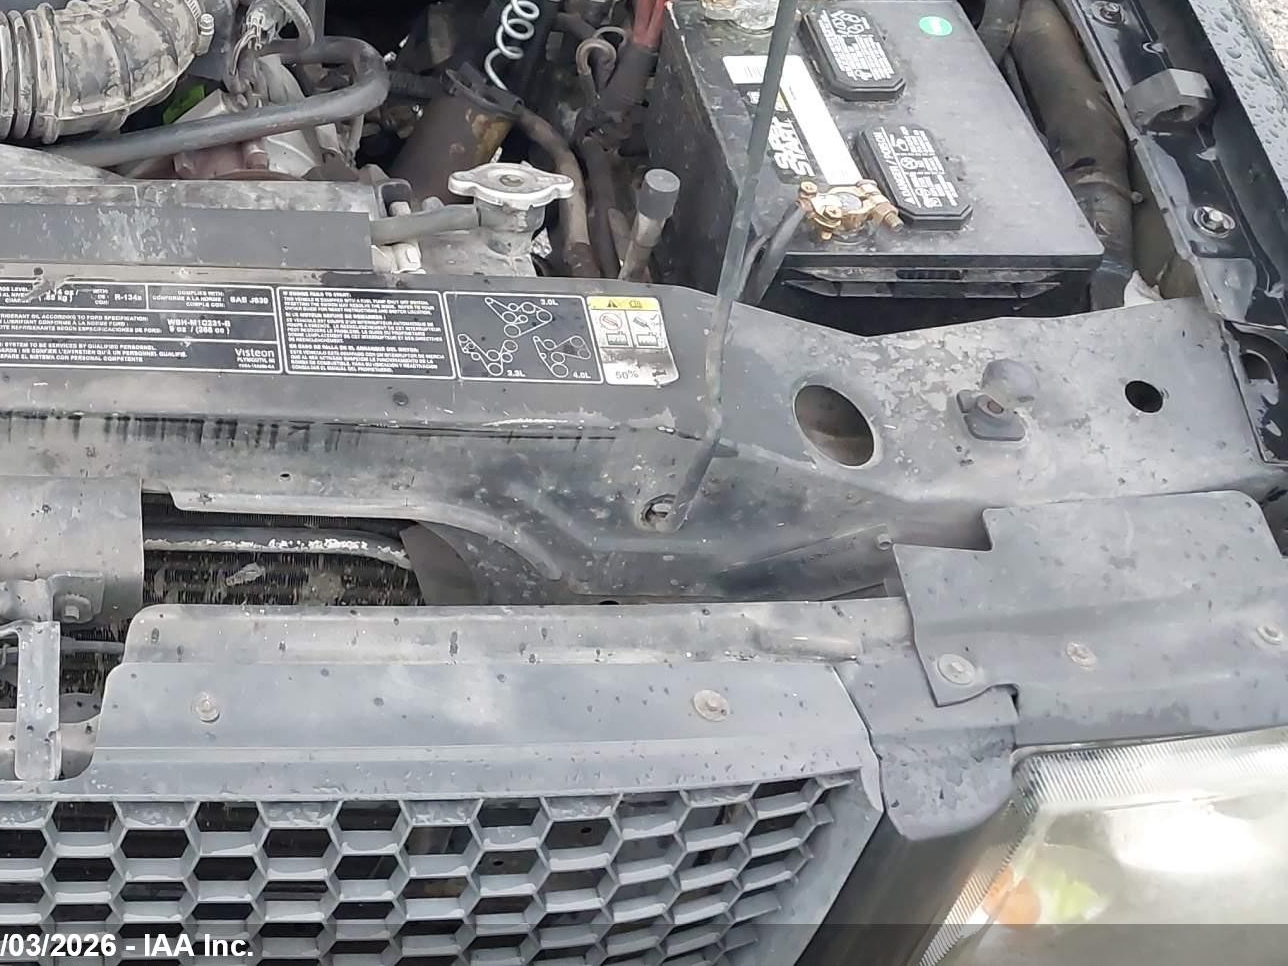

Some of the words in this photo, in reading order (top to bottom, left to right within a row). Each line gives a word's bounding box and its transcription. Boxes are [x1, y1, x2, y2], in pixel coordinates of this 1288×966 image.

[540, 298, 559, 306] 3.0L
[234, 347, 275, 357] Visteon
[572, 371, 592, 379] 4.0L
